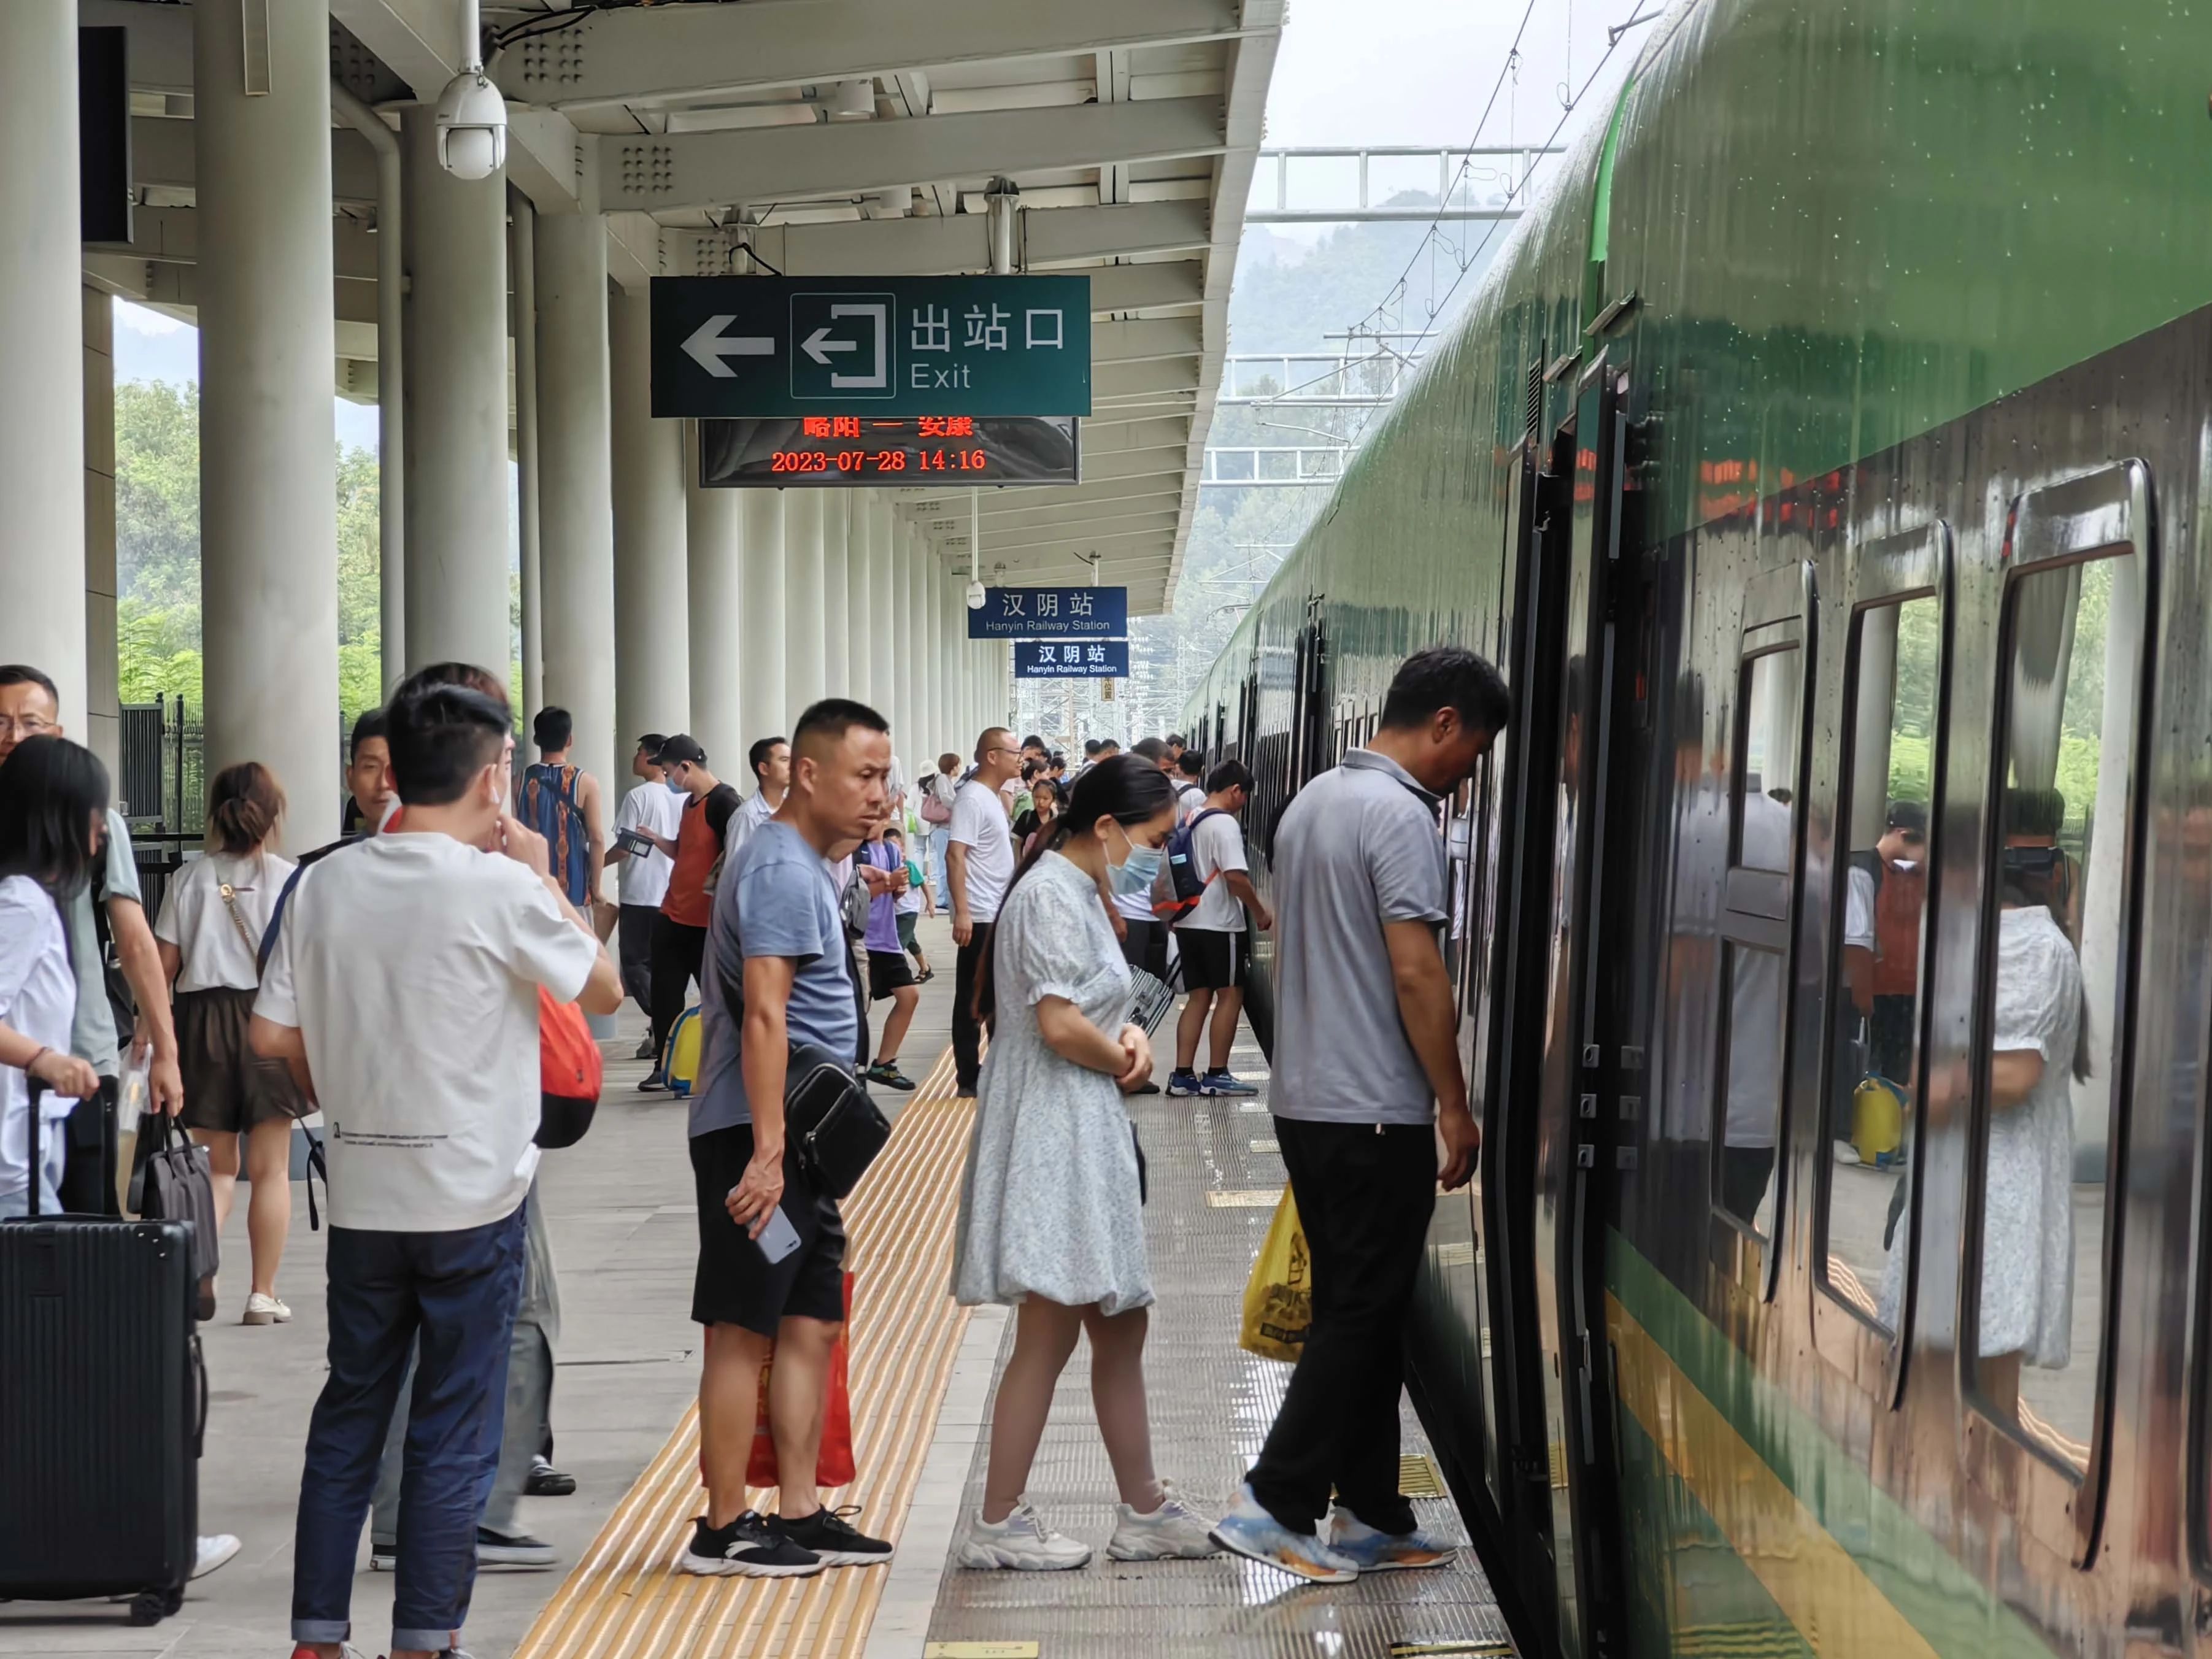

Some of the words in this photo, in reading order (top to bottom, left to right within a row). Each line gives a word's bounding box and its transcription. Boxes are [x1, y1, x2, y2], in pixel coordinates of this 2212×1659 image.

[911, 303, 1064, 352] 出站口
[911, 363, 971, 389] Exit
[918, 417, 973, 437] 安康
[771, 451, 906, 472] 2023-07-28
[919, 449, 986, 471] 14:16
[1002, 592, 1093, 617] 汉阴站
[986, 621, 1023, 633] Hanyin
[1027, 620, 1069, 633] Railway
[1073, 620, 1110, 631] Station
[1038, 645, 1105, 663] 汉阴站
[1027, 665, 1054, 674] Hanyin
[1057, 665, 1087, 674] Railway
